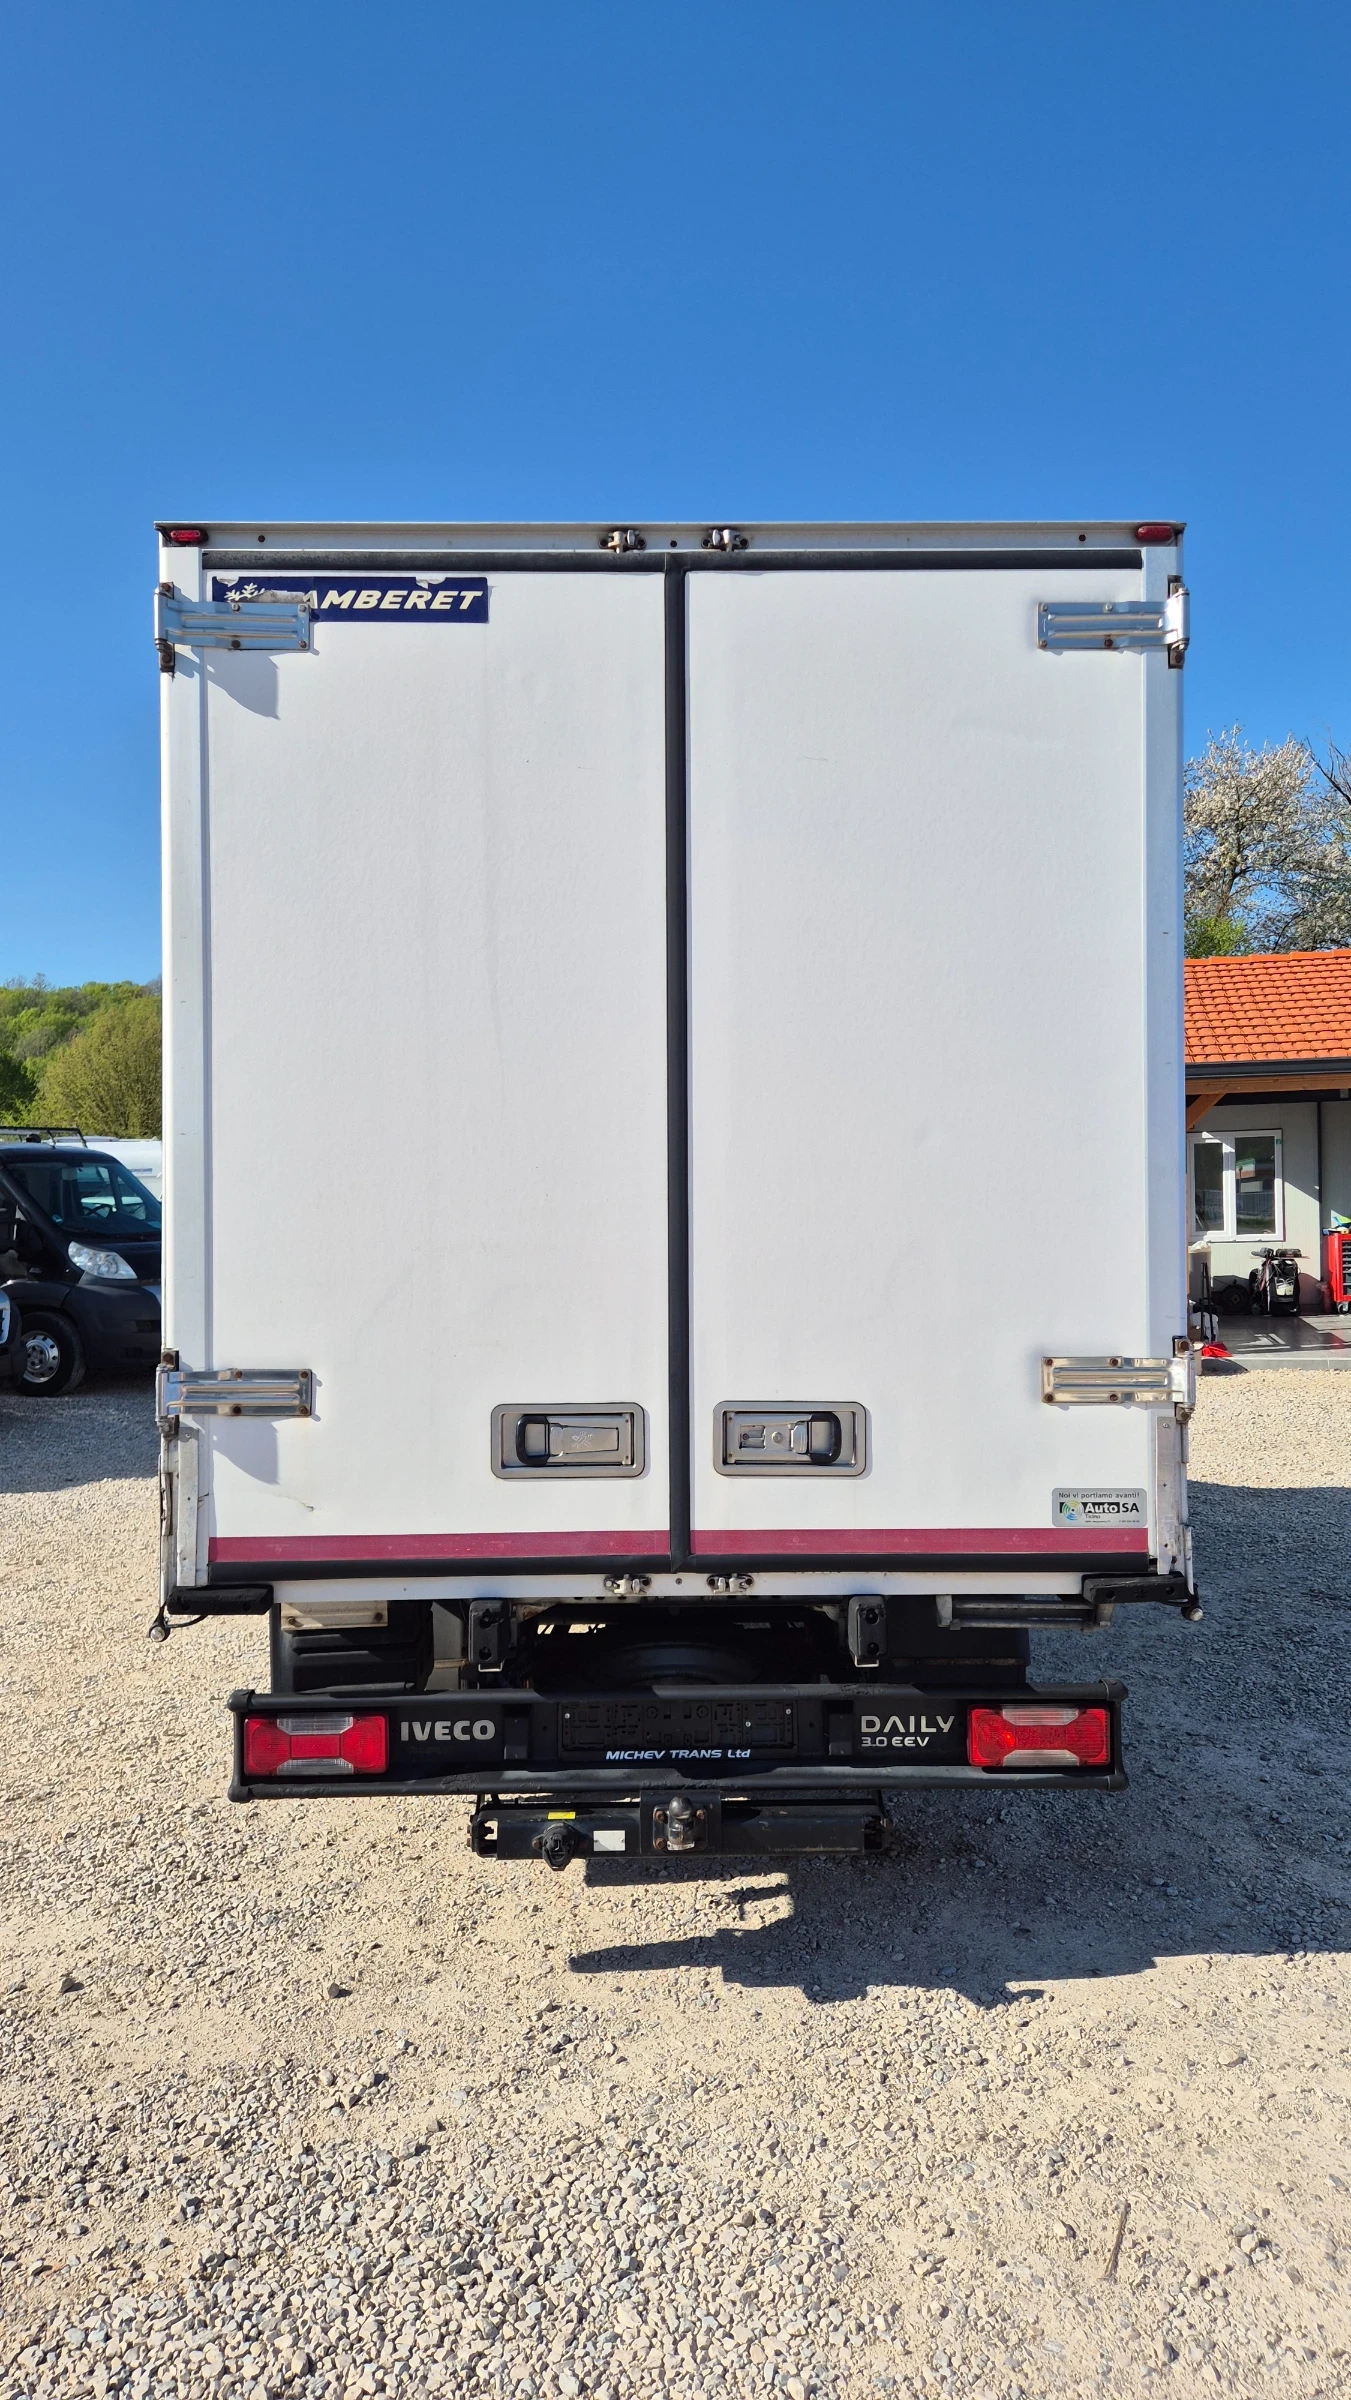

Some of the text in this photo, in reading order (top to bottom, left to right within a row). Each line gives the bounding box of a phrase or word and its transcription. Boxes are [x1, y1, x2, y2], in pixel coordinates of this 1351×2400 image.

[1081, 1492, 1113, 1500] portiamo
[1115, 1491, 1140, 1499] avanti!
[861, 1715, 955, 1733] DAILY
[400, 1719, 496, 1742] IVECO
[861, 1736, 930, 1747] 3.0 EEV
[605, 1748, 751, 1760] MICHEV TRANS Ltd
